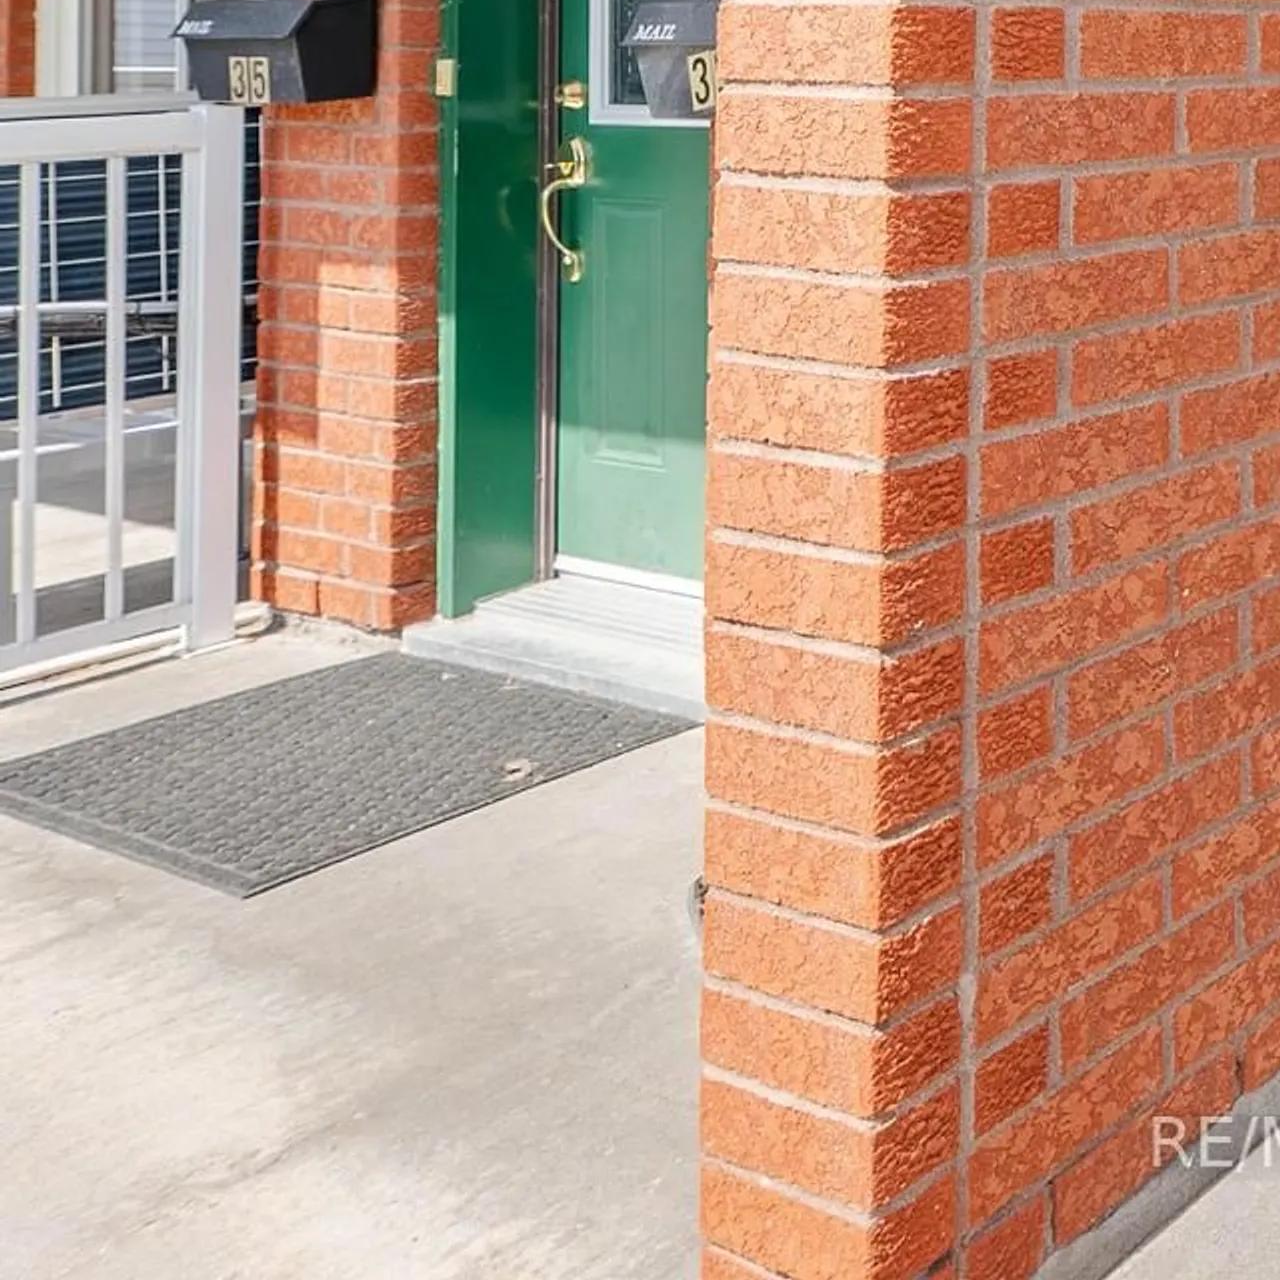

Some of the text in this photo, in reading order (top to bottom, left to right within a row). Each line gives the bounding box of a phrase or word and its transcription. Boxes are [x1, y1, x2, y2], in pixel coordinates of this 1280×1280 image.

[633, 24, 677, 40] MAIL
[231, 59, 267, 99] 35
[692, 55, 716, 105] 3
